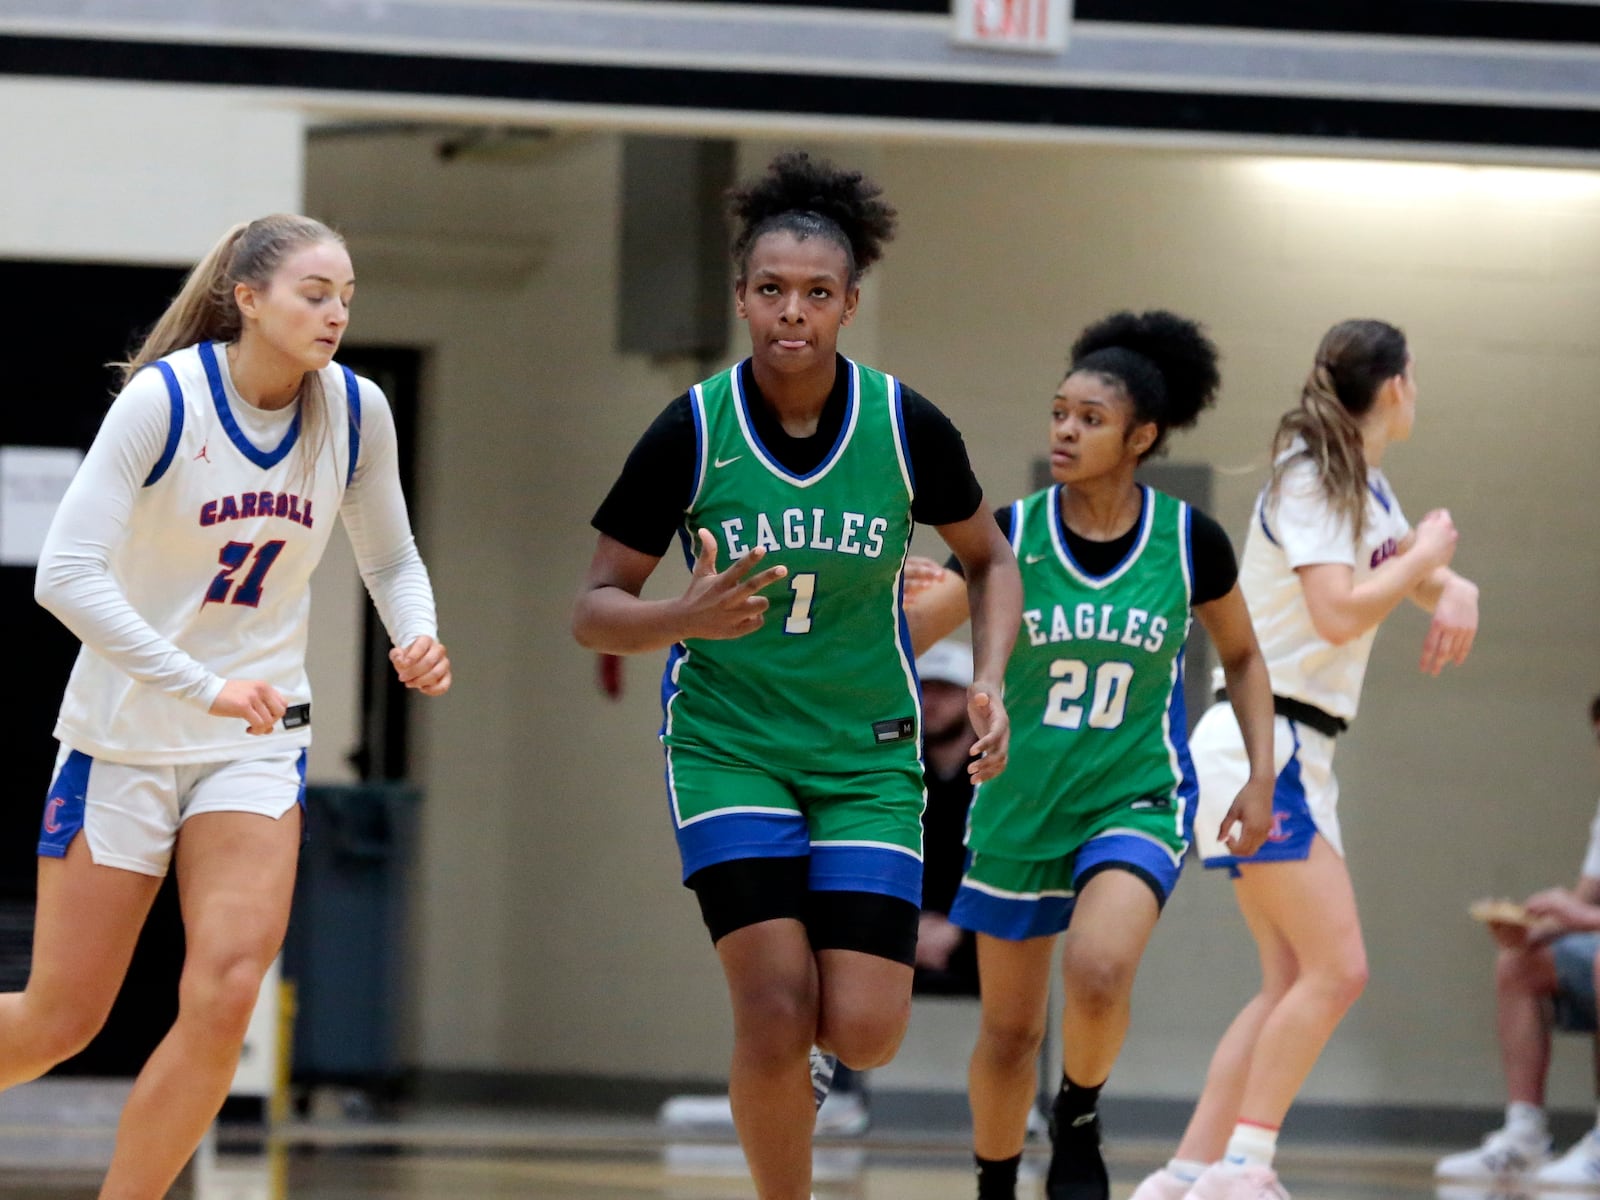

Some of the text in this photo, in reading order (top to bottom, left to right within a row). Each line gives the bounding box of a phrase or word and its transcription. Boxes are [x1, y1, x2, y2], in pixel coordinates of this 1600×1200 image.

[199, 491, 314, 528] CARROLL
[721, 508, 888, 560] EAGLES
[200, 540, 287, 612] 21
[784, 573, 816, 634] 1
[1023, 603, 1168, 653] EAGLES
[1042, 659, 1134, 730] 20
